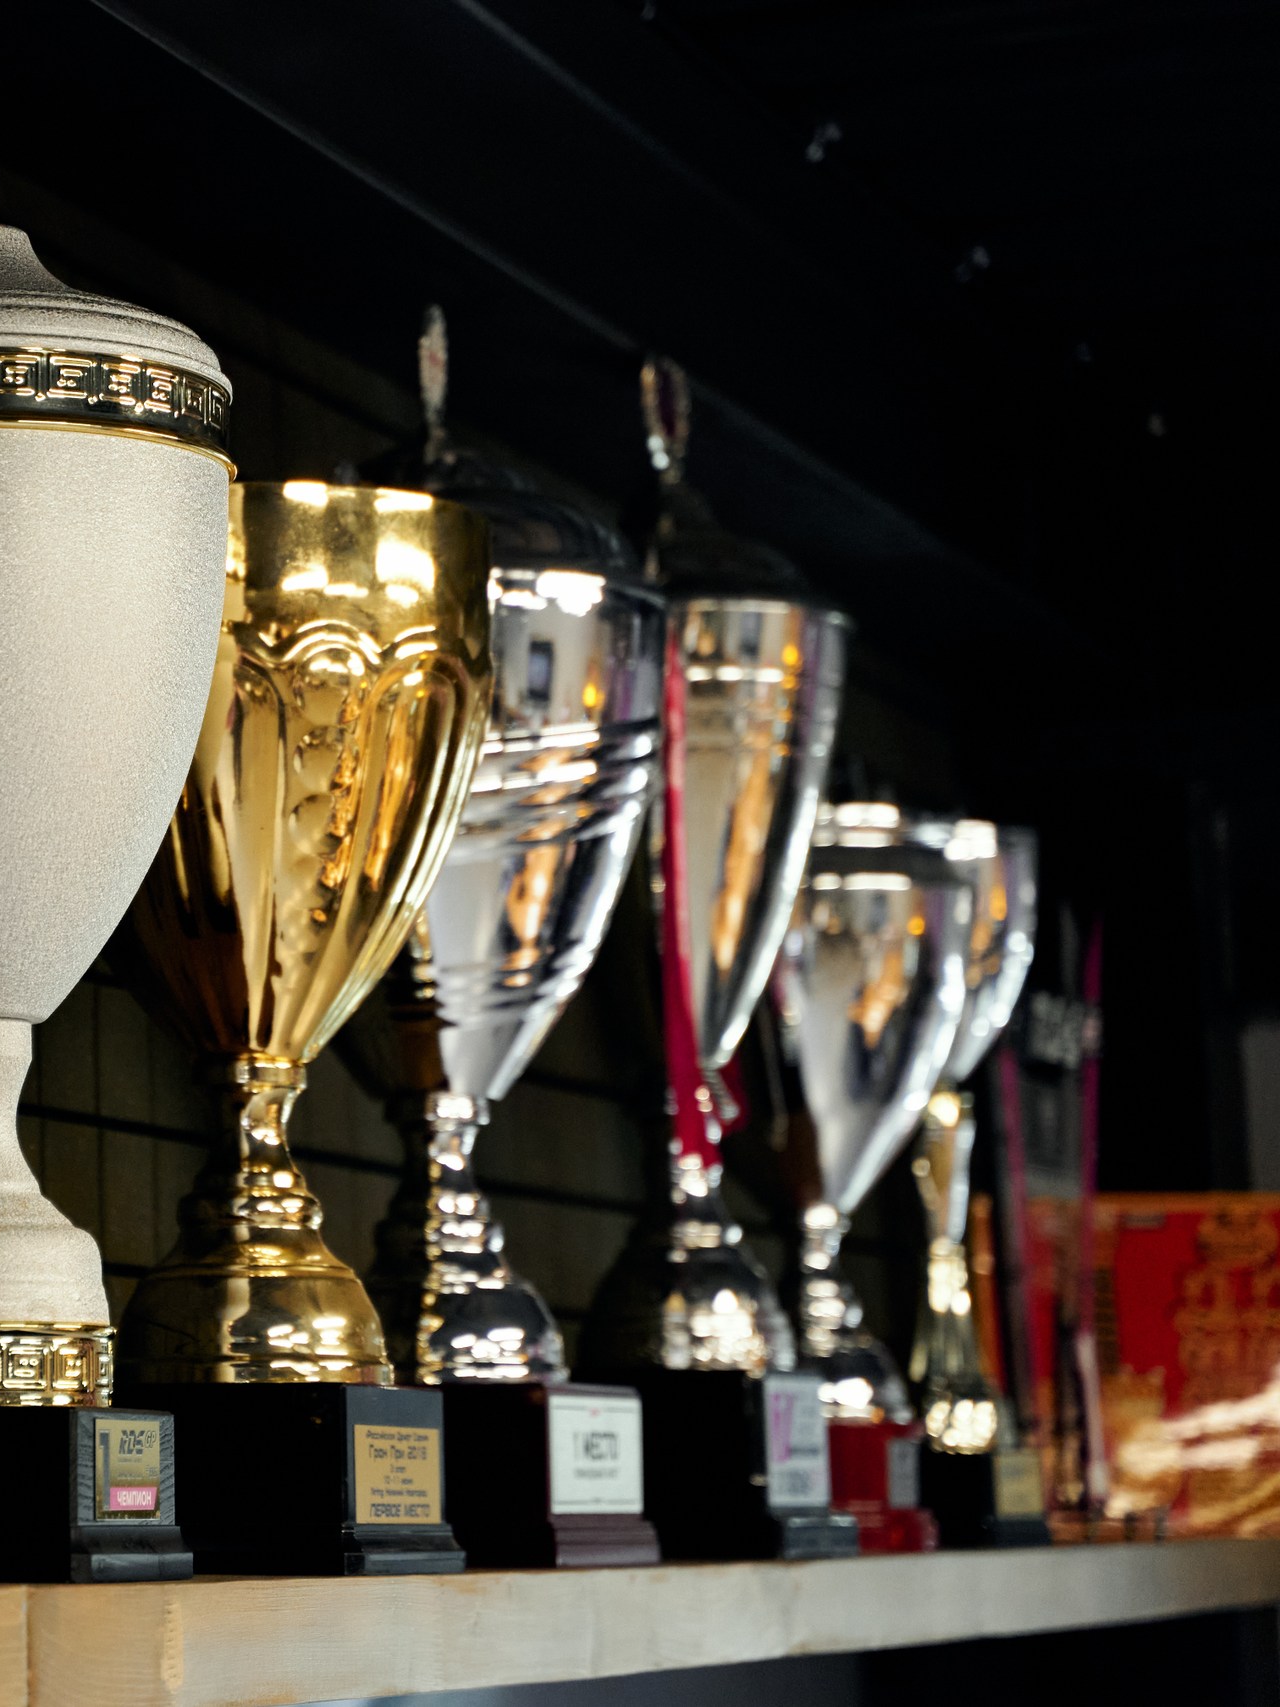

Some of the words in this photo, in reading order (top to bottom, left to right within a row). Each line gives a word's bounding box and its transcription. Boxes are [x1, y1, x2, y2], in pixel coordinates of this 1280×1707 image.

[118, 1429, 146, 1455] RDS
[144, 1430, 157, 1449] GP
[369, 1444, 388, 1462] Гран
[390, 1445, 405, 1462] При
[581, 1431, 618, 1461] МЕСТО
[99, 1429, 111, 1510] 1
[116, 1490, 152, 1506] ЧЕМПИОН
[370, 1502, 402, 1518] ПЕРВОЕ
[403, 1502, 431, 1518] МЕСТО
